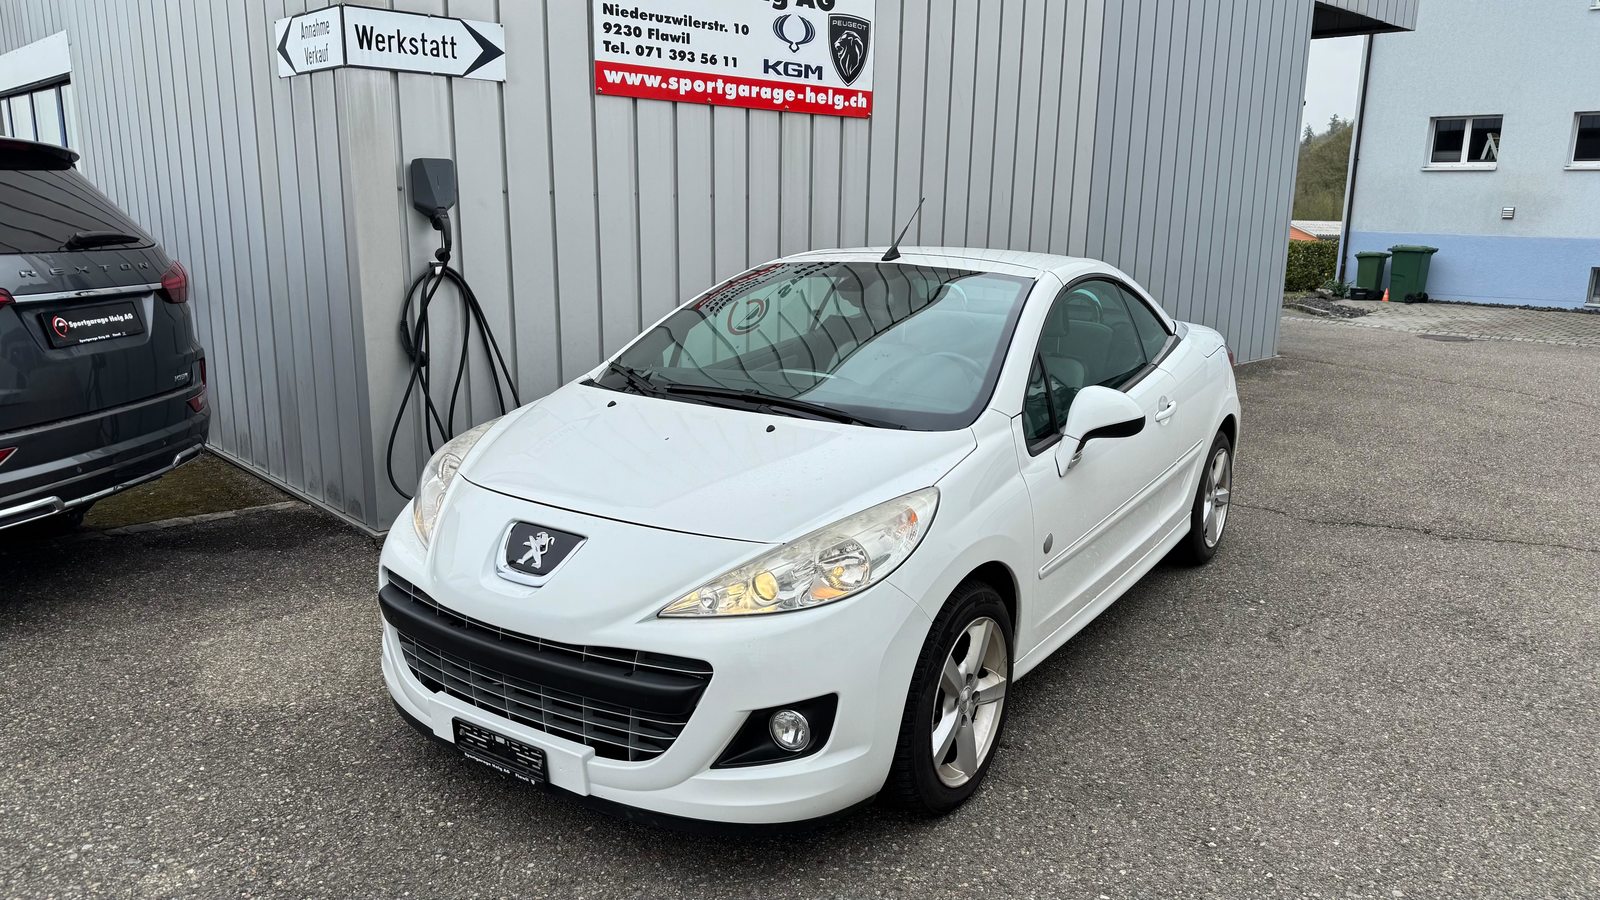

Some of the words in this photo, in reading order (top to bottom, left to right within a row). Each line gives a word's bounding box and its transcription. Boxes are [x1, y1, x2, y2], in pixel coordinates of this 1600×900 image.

[301, 19, 330, 41] Annahme
[602, 3, 729, 33] Niederuzwilerstr.
[733, 22, 750, 36] 10
[832, 18, 868, 31] PEUGEOT
[354, 23, 458, 60] Werkstatt
[602, 21, 643, 39] 9230
[647, 28, 691, 45] Flawil
[304, 42, 329, 66] Verkauf
[602, 40, 630, 56] Tel.
[635, 44, 662, 59] 071
[669, 48, 695, 64] 393
[700, 52, 718, 66] 56
[723, 55, 738, 68] 11
[763, 58, 823, 80] KGM
[603, 68, 867, 109] www.sportgarage-helg.ch
[19, 262, 149, 278] REXTON
[68, 316, 109, 329] Sportgarage
